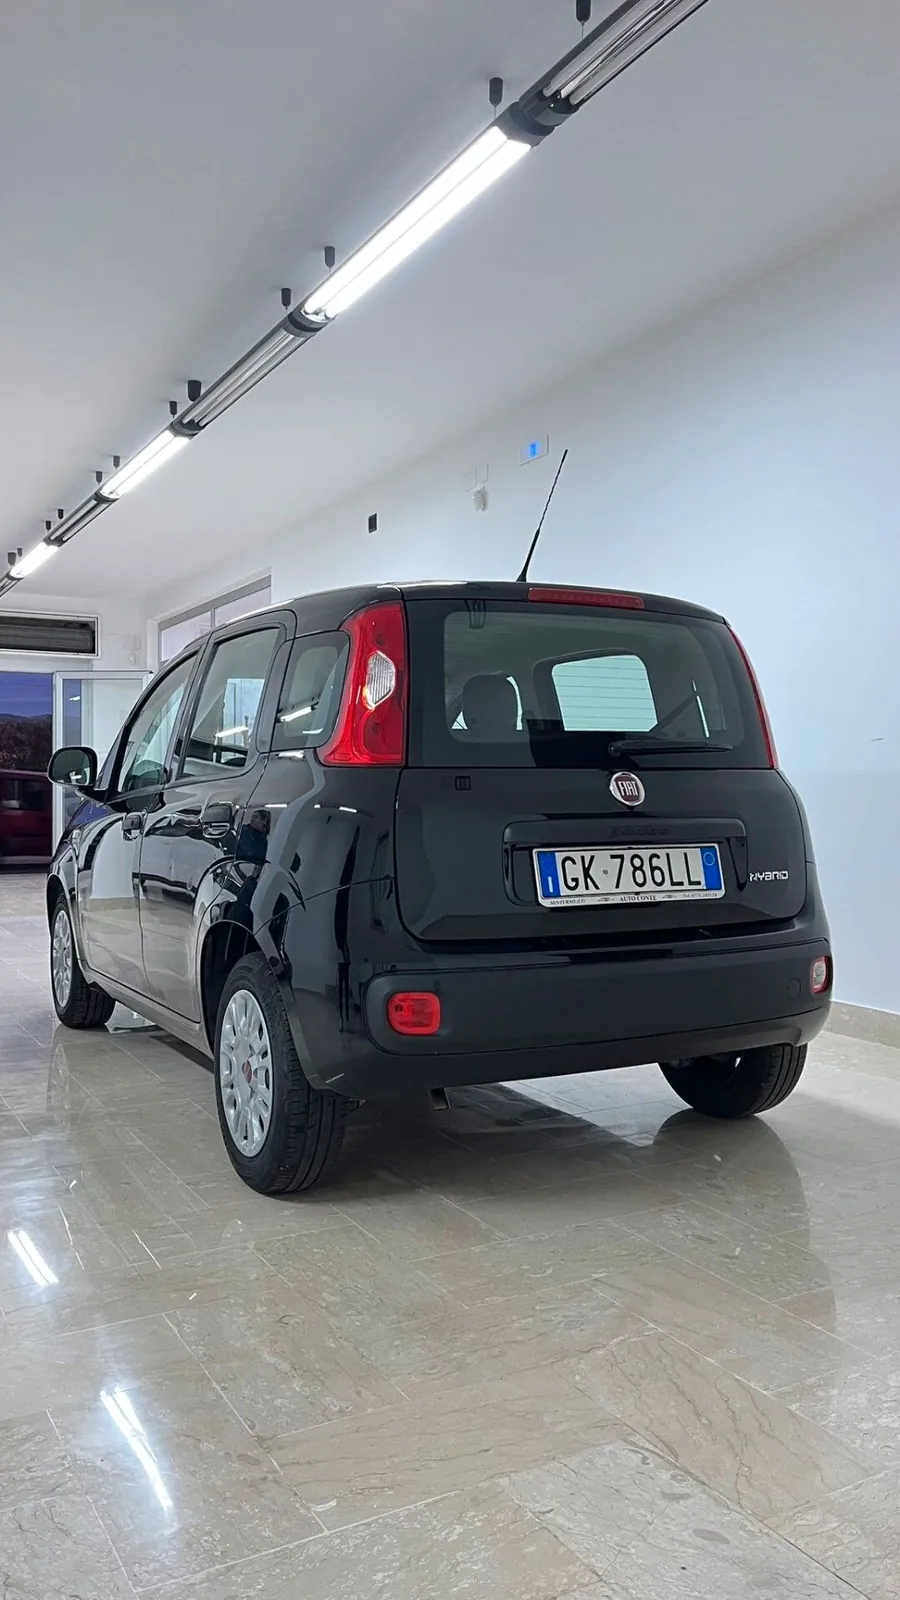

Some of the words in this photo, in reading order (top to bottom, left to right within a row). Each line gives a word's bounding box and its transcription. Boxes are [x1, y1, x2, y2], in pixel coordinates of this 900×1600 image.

[617, 780, 638, 796] FIAT
[561, 854, 600, 891] GK
[609, 852, 702, 889] 786LL
[749, 870, 789, 882] HYBRID
[636, 894, 657, 902] CONTE
